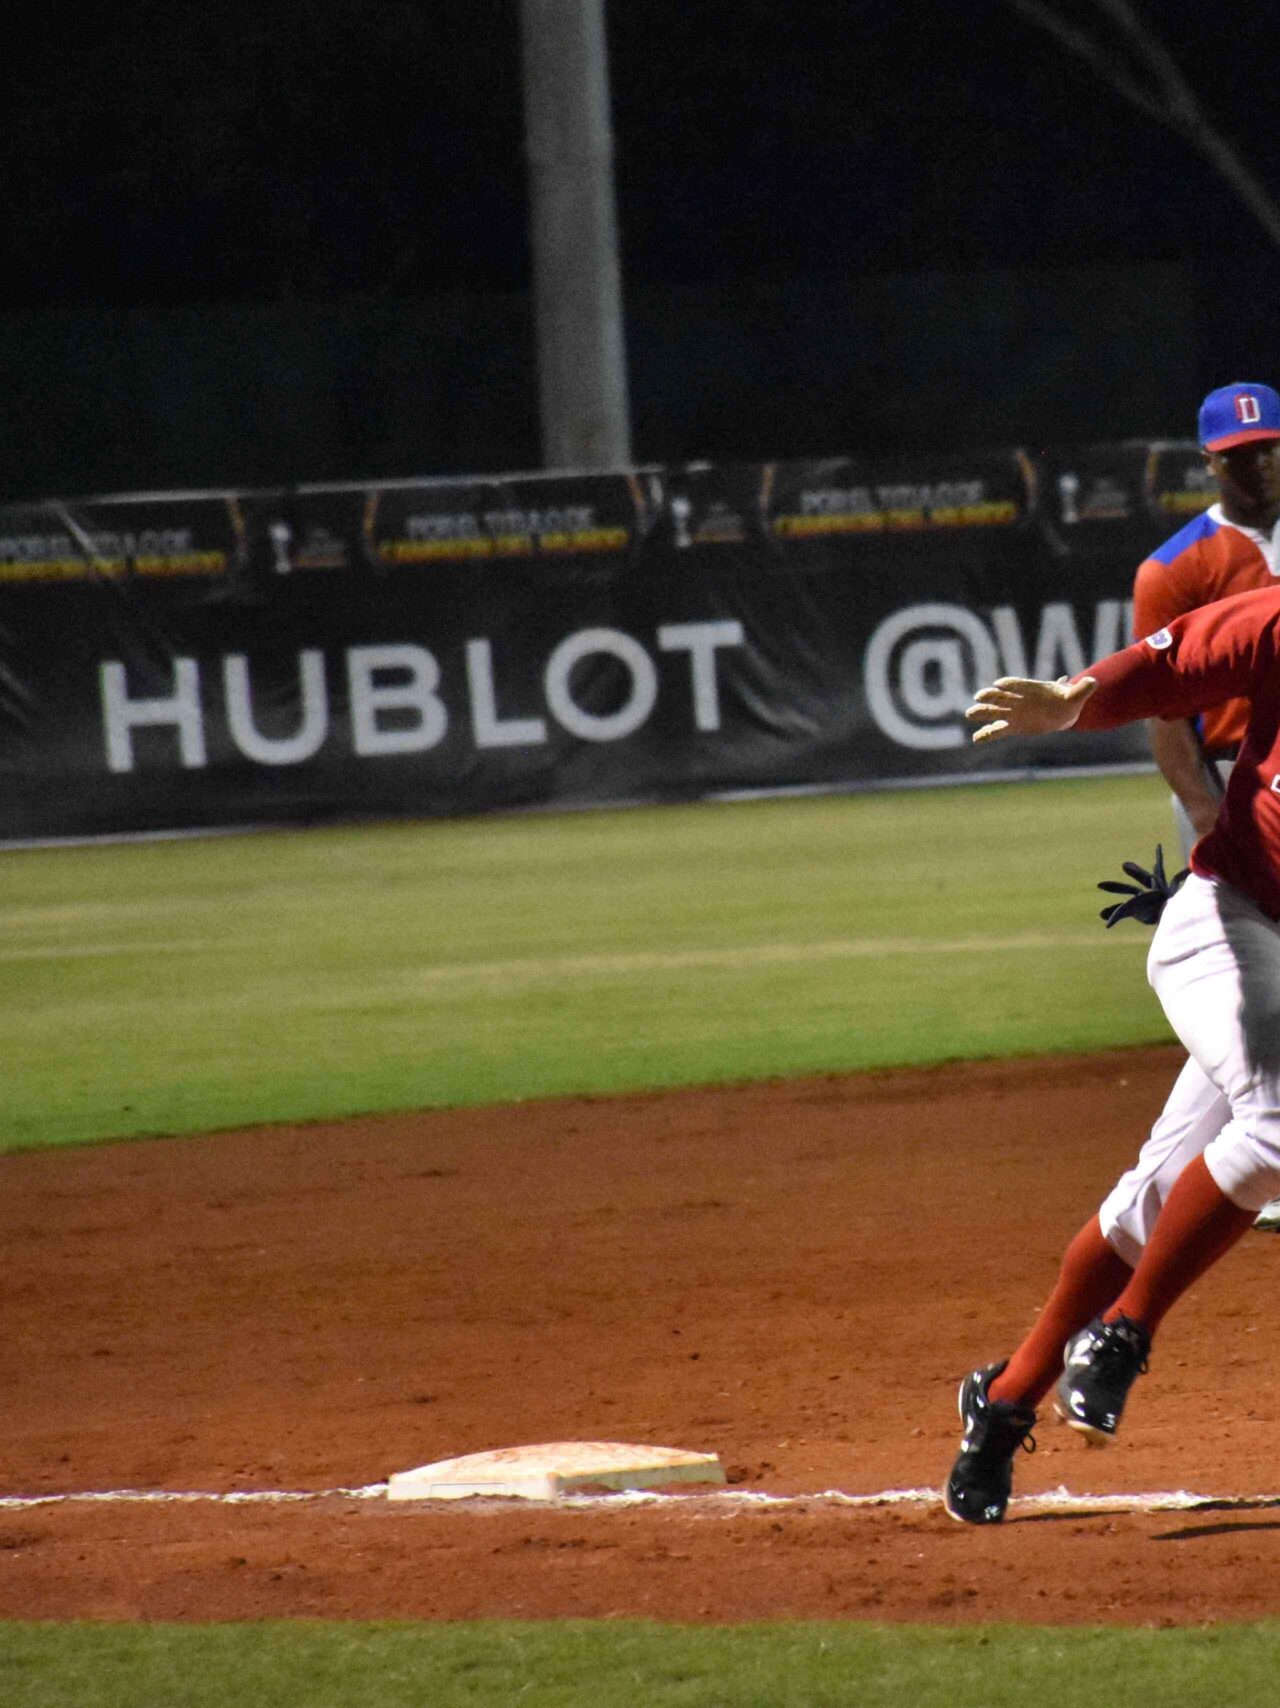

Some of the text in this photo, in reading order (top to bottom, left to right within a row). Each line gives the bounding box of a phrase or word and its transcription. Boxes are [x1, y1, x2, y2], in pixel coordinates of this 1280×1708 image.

[1234, 392, 1261, 423] D
[101, 620, 745, 773] HUBLOT
[864, 601, 1136, 751] @W
